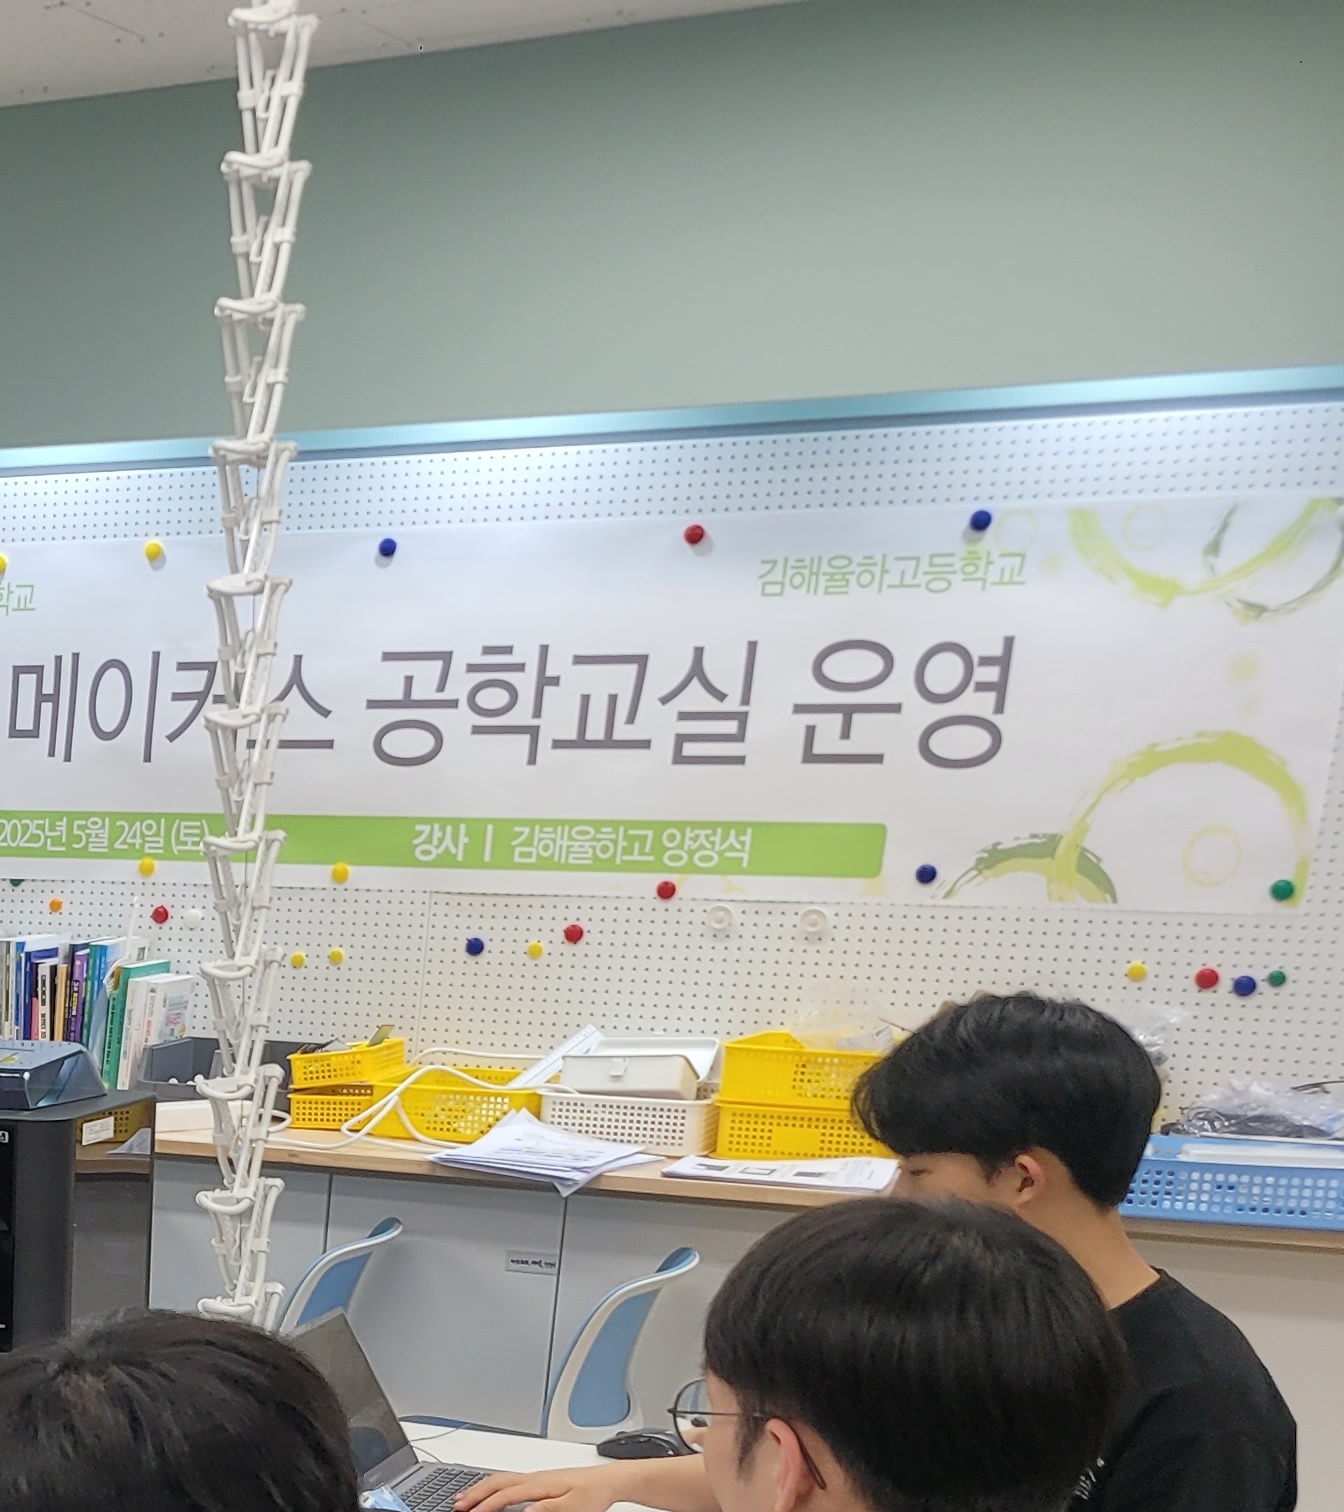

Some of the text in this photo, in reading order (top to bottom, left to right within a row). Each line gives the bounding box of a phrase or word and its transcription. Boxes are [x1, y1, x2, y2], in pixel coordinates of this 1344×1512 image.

[758, 551, 1026, 597] 김해율하고등학교
[366, 639, 758, 767] 공학교실
[793, 635, 1015, 770] 운영
[72, 817, 109, 852] 5월
[114, 818, 165, 854] 24일
[412, 823, 753, 868] 강사 김해율하고 양정석
